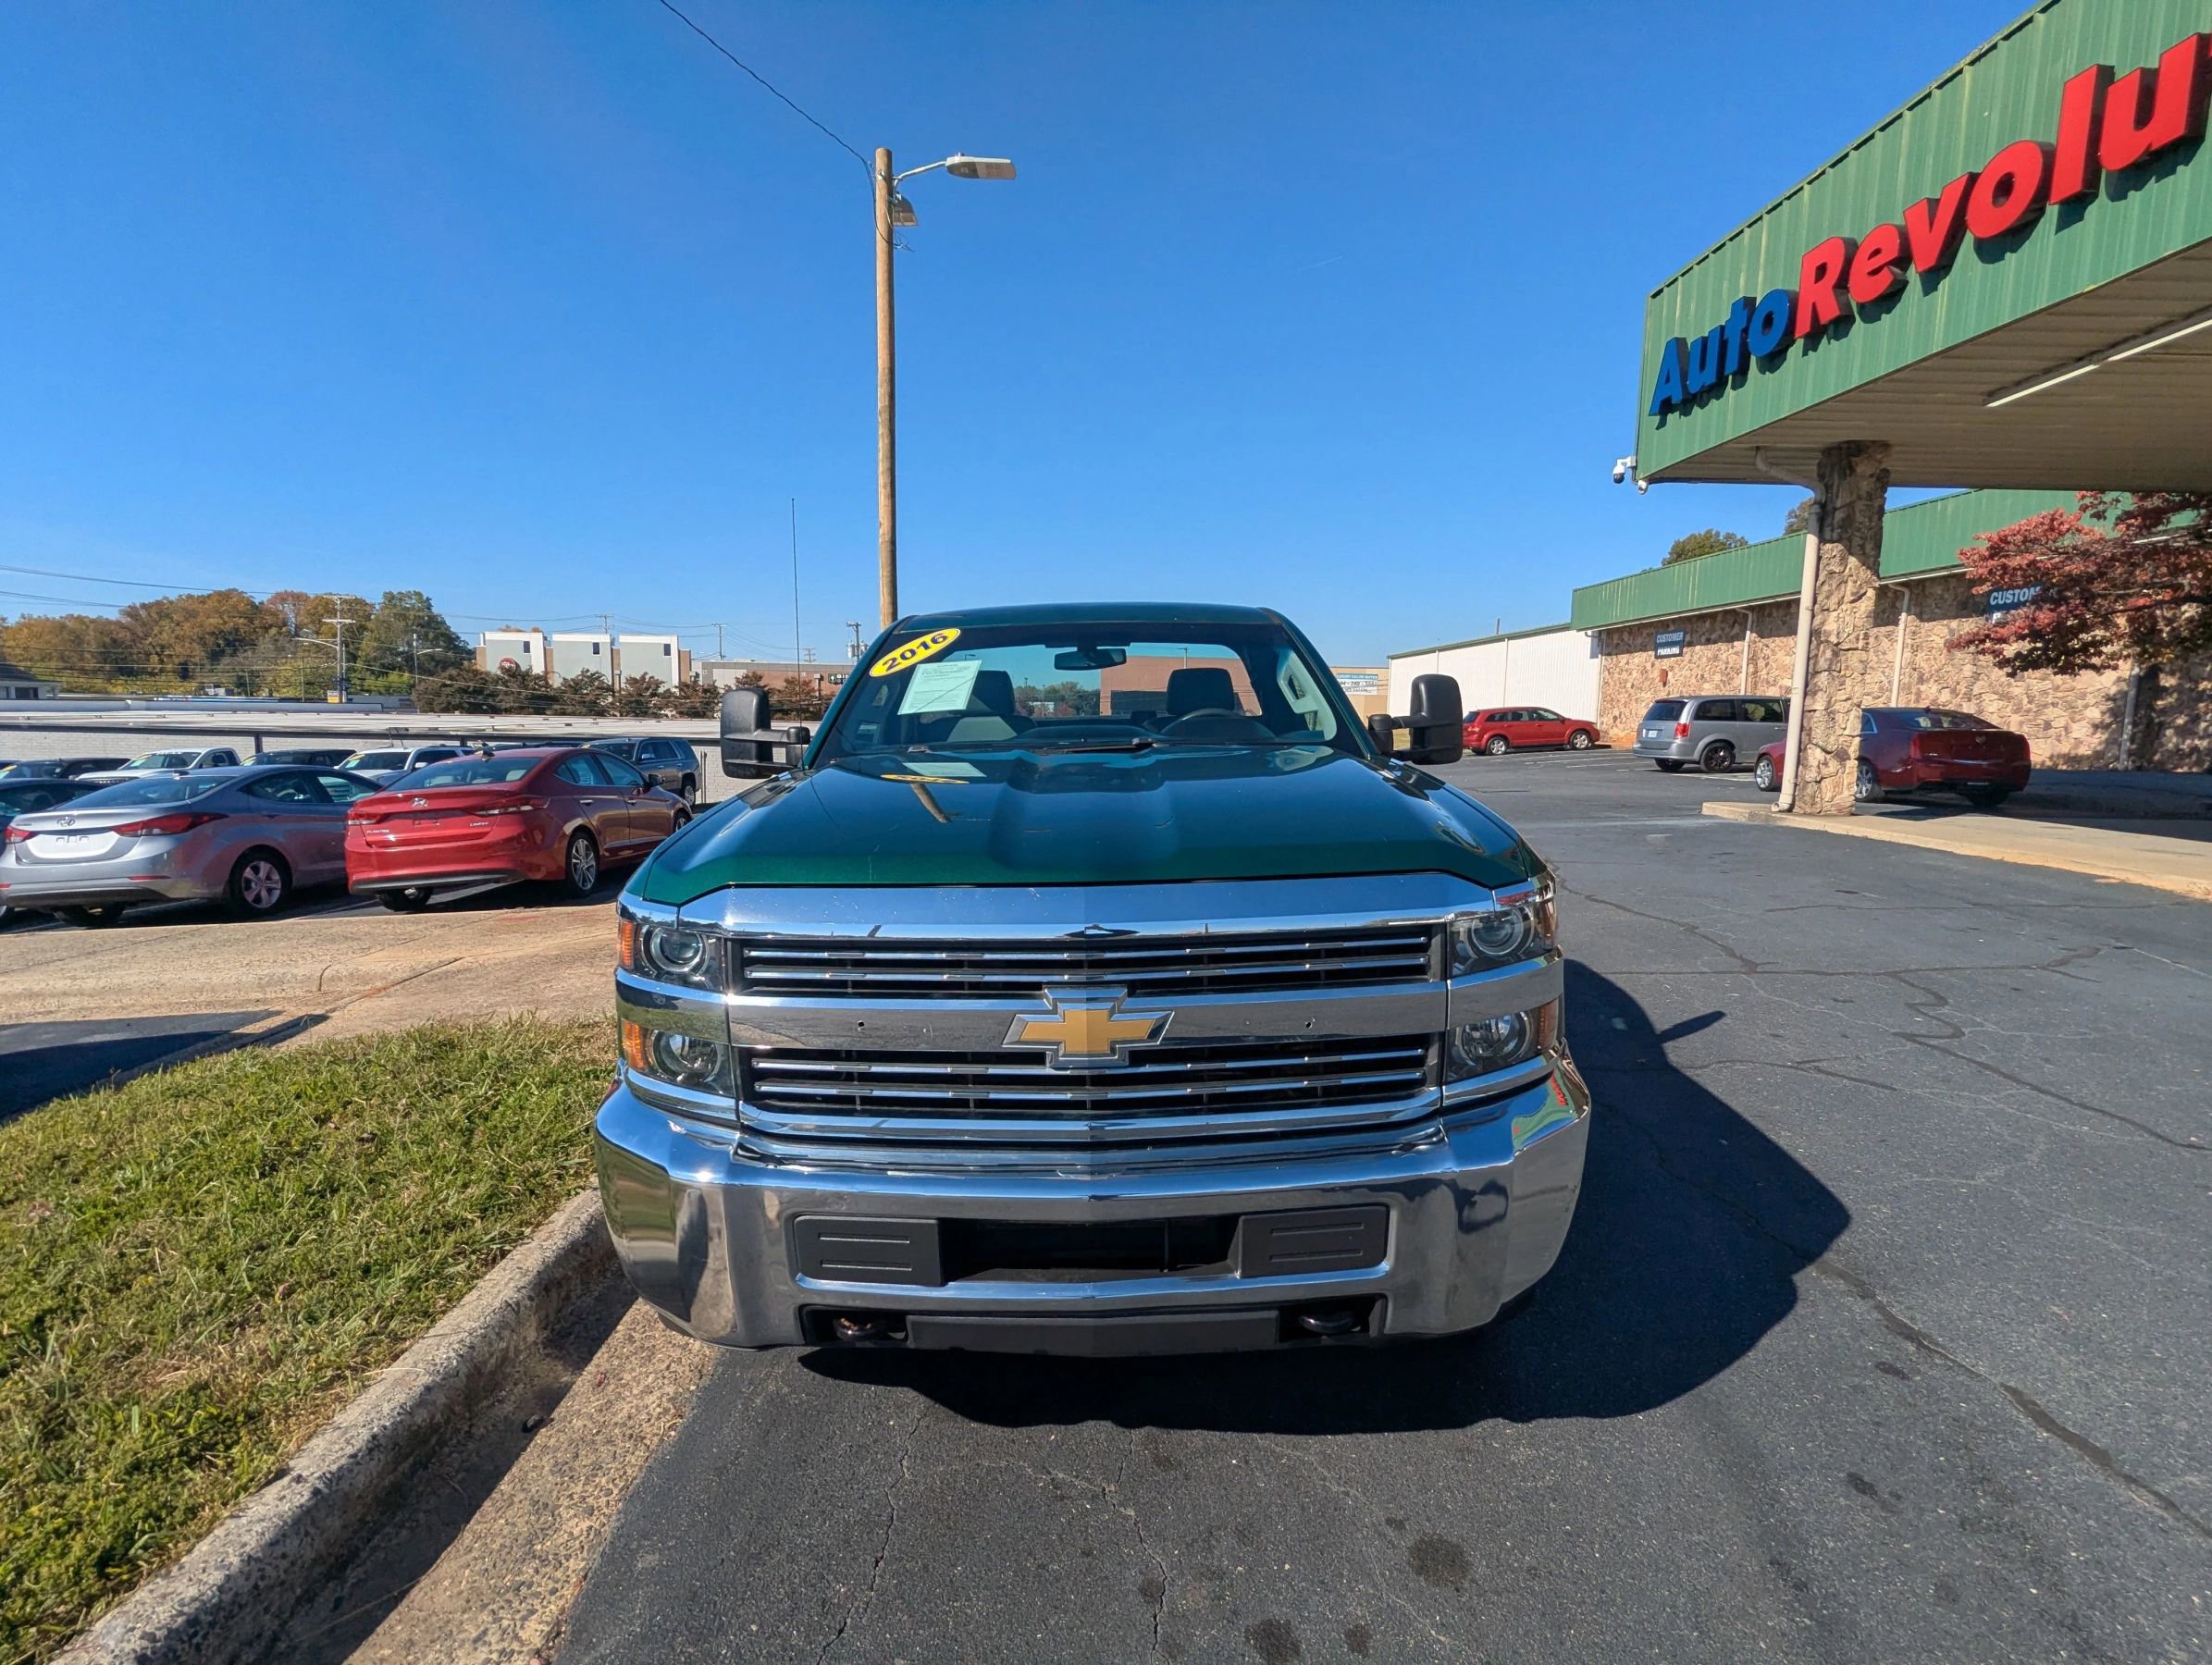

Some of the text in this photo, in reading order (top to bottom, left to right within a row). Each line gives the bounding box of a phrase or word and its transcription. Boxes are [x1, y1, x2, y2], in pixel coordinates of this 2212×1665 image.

[1648, 31, 2212, 417] AutoRevolu
[1989, 586, 2058, 606] CUSTOM
[1657, 632, 1684, 643] CUSTOMER
[883, 633, 948, 672] 2016
